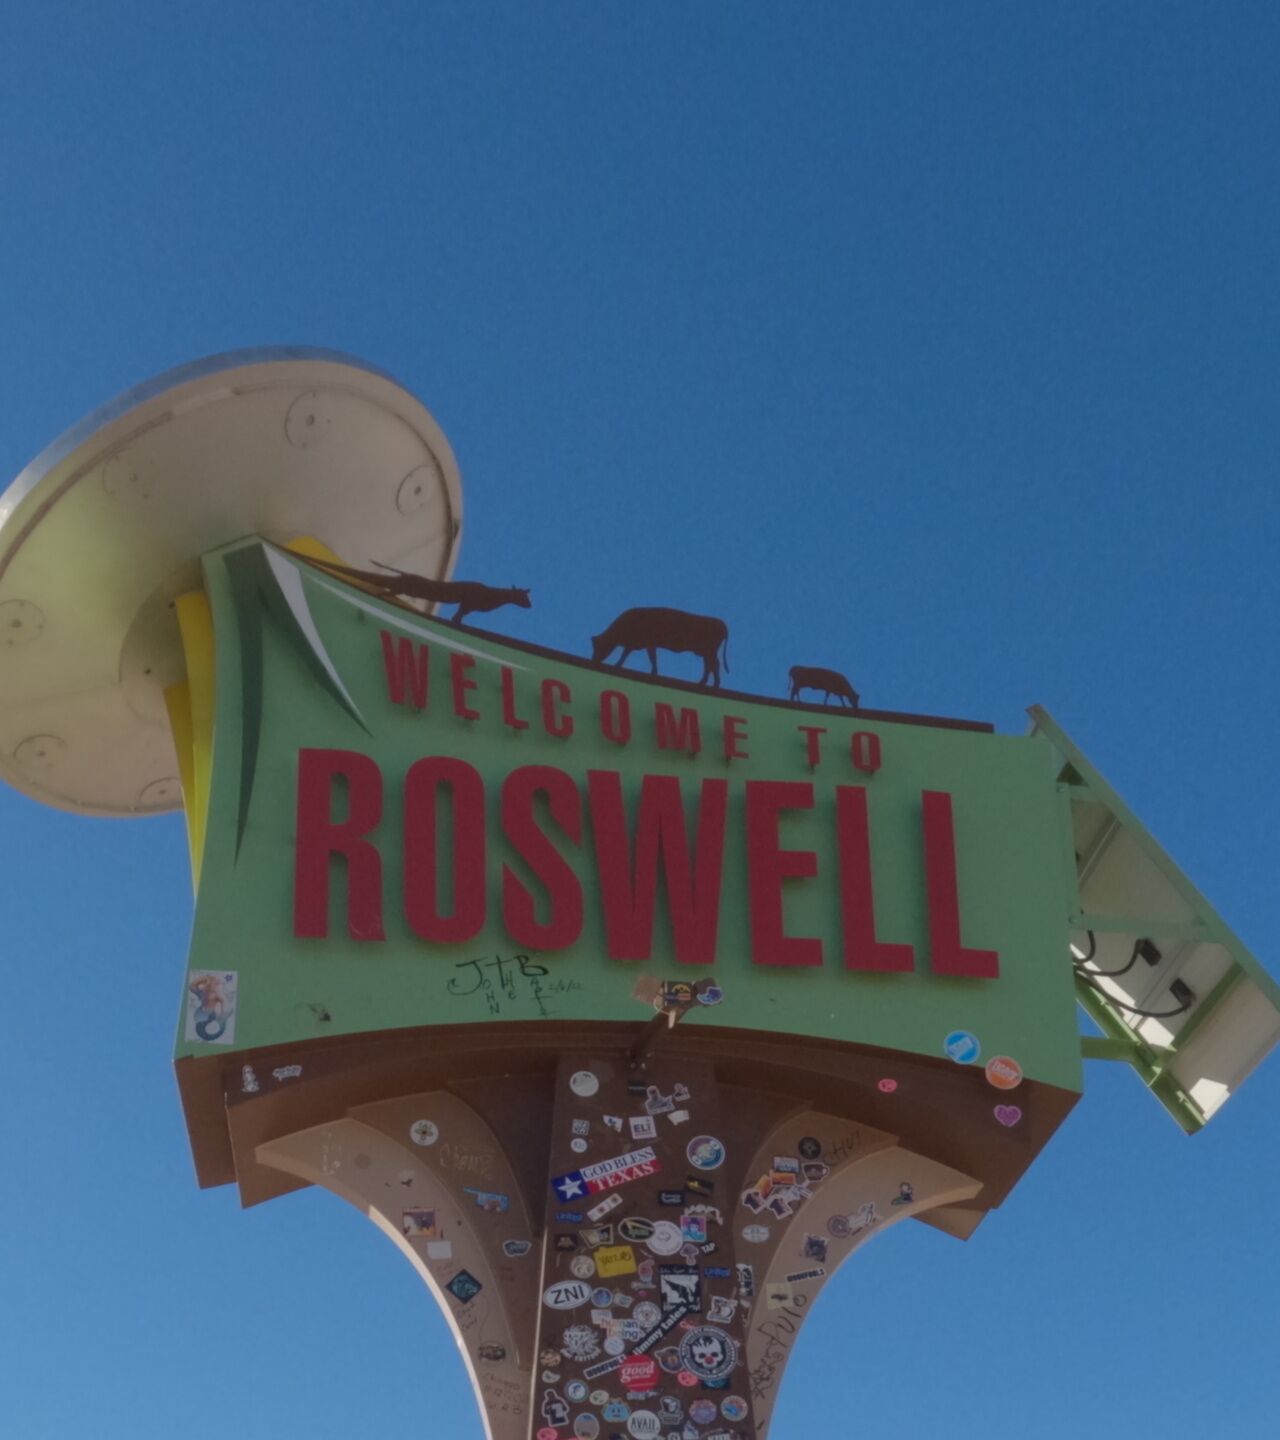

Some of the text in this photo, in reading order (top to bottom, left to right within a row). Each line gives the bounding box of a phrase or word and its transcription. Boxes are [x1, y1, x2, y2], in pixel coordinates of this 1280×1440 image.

[380, 630, 882, 773] WELCOME TO
[292, 747, 1001, 980] ROSWELL
[582, 1148, 655, 1180] GOD BLESS
[593, 1163, 656, 1191] TEXAS
[620, 1361, 655, 1384] good
